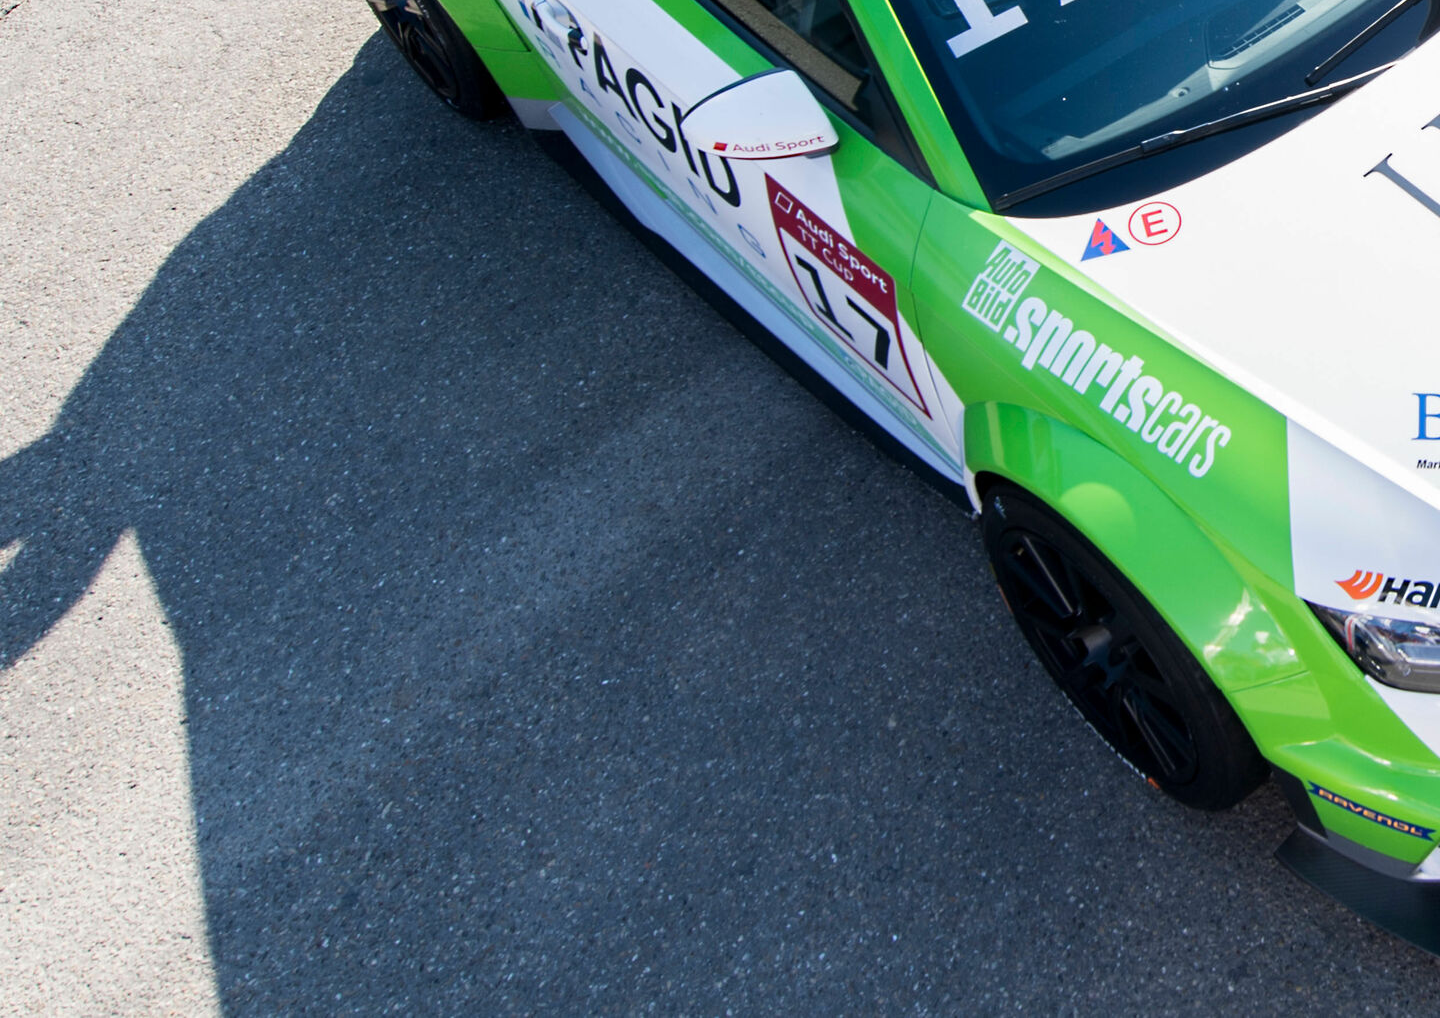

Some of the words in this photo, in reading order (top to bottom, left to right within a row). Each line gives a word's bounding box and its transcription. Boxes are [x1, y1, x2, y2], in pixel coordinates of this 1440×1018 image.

[732, 141, 771, 154] Audi
[774, 134, 825, 152] Sport
[1142, 210, 1168, 238] E
[795, 208, 834, 251] Audi
[837, 241, 888, 293] Sport
[798, 227, 819, 254] TT
[822, 247, 854, 283] Cup
[986, 246, 1032, 296] Auto
[795, 255, 890, 371] 17
[967, 278, 1013, 326] Bild
[1003, 296, 1232, 478] sportscars
[1318, 788, 1424, 837] RAVENOL
